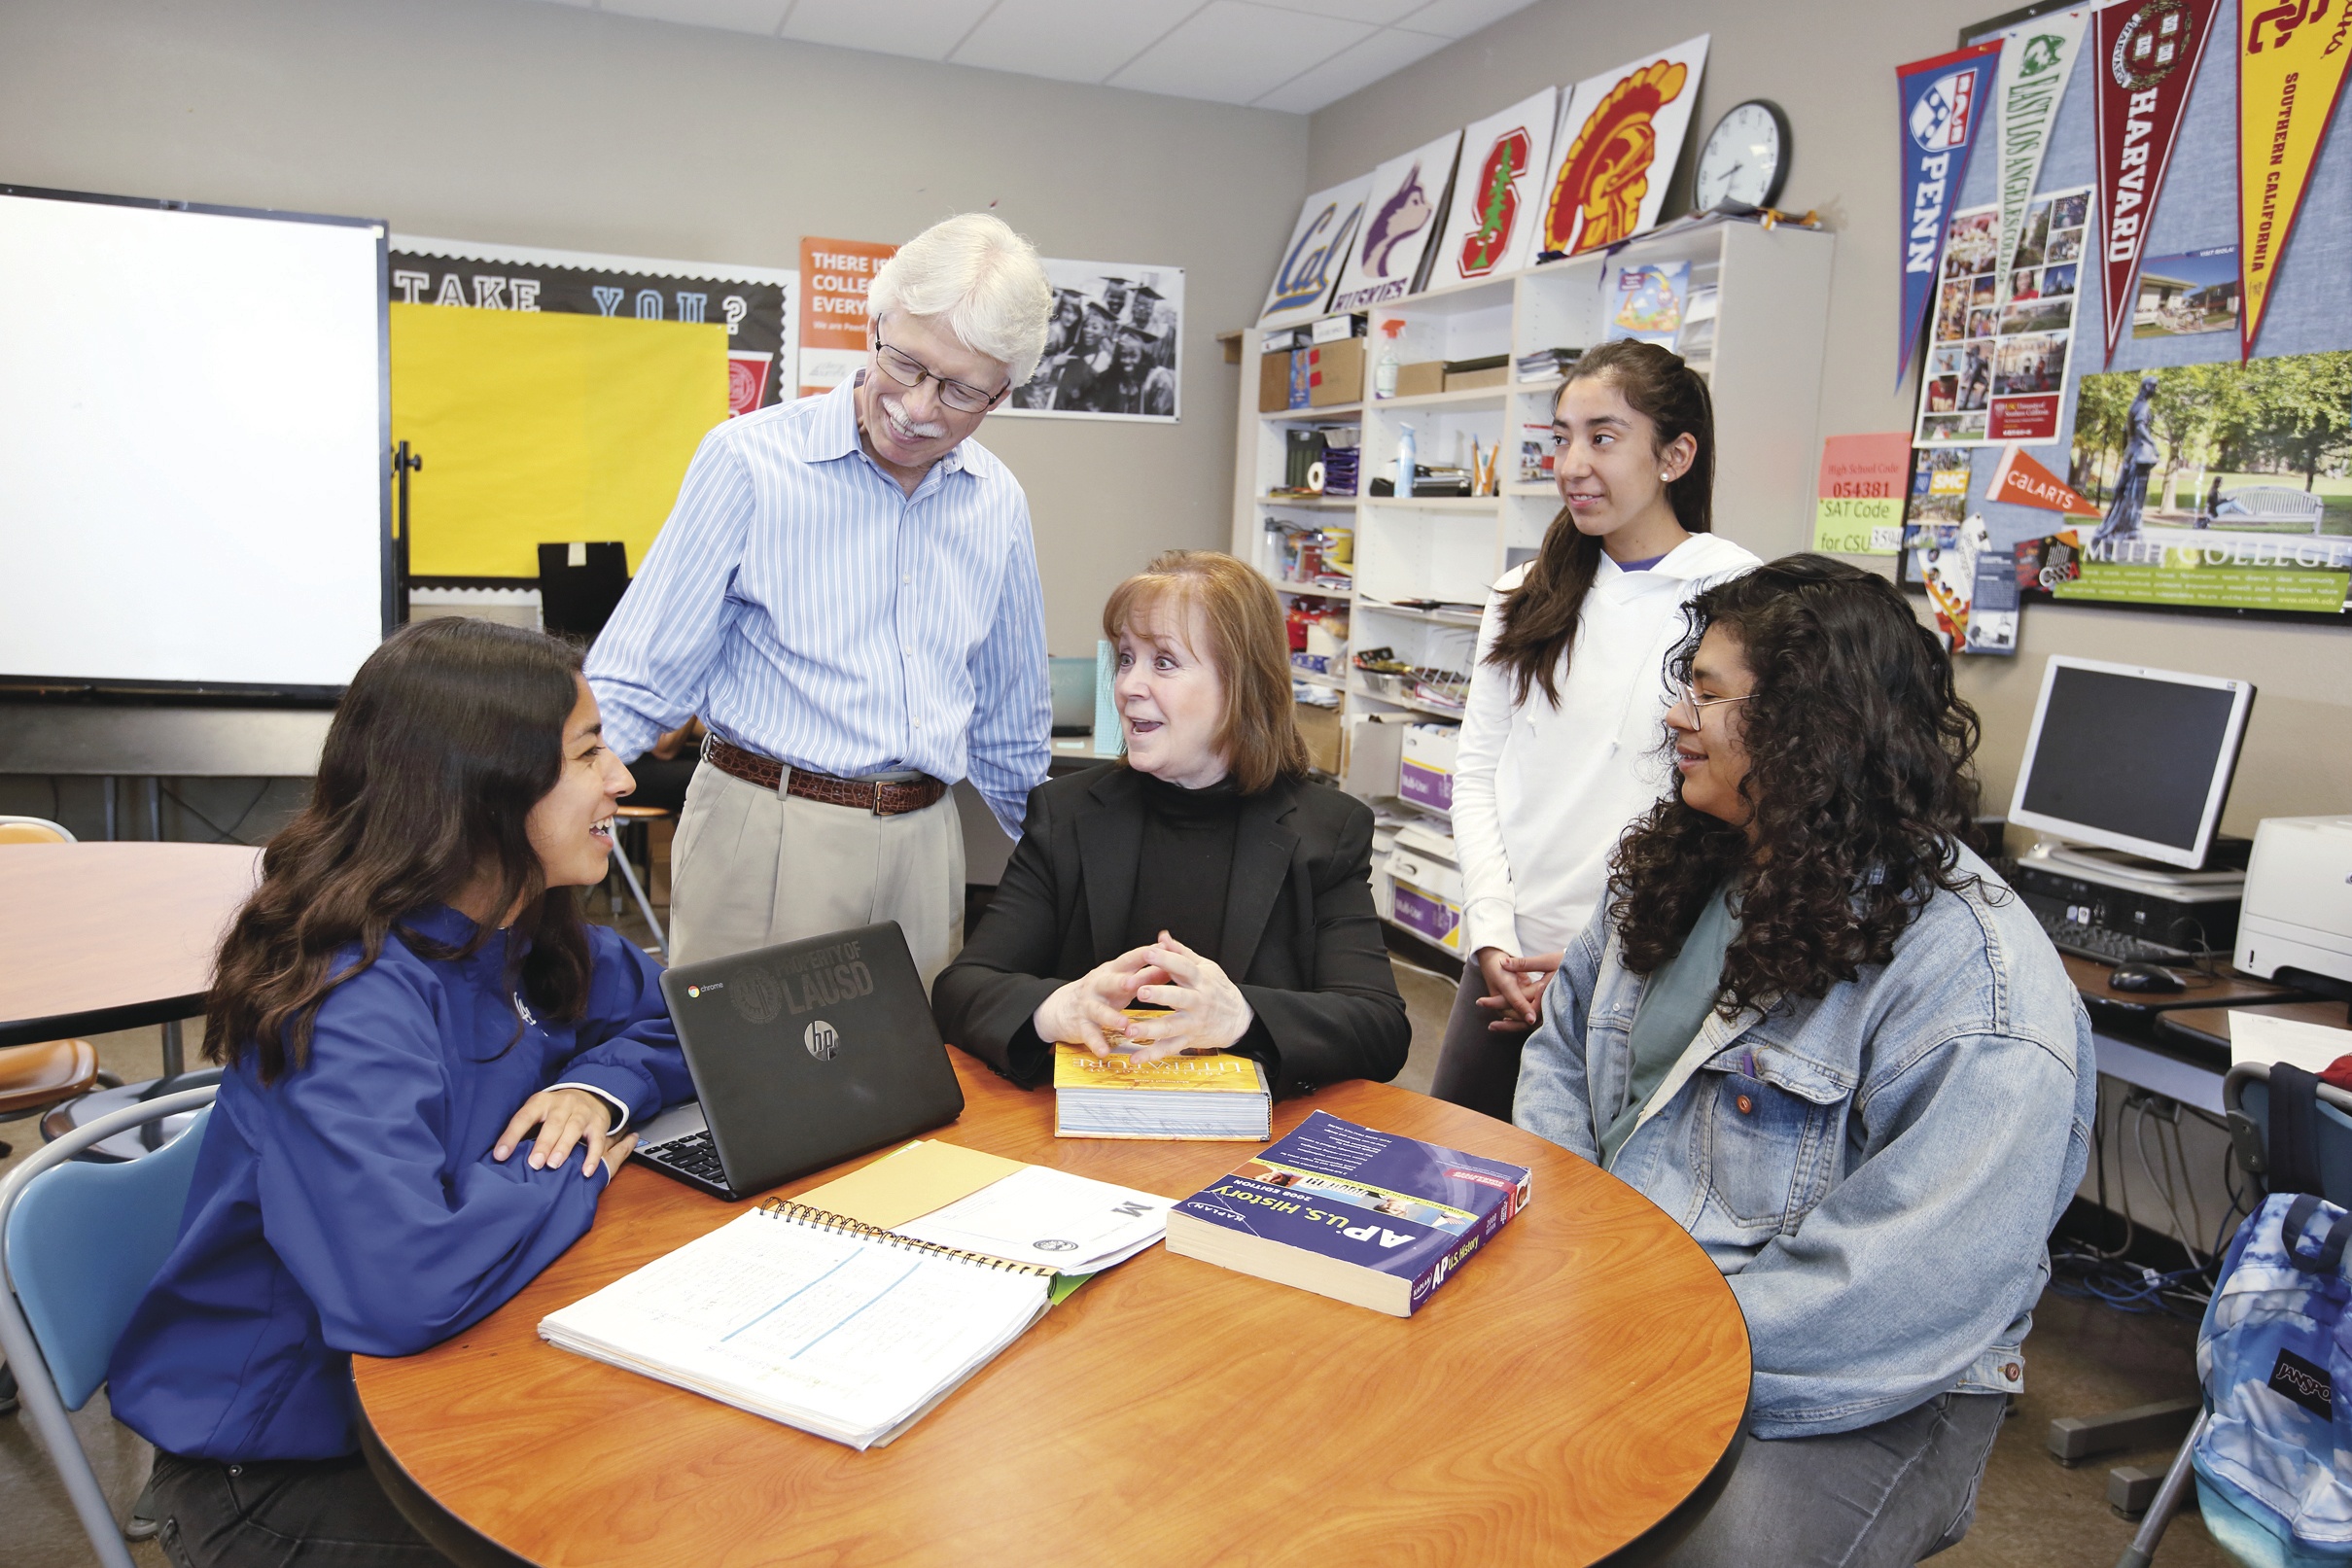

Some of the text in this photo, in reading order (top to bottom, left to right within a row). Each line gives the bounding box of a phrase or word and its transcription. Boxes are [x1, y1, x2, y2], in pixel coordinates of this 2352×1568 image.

[2007, 73, 2060, 121] EAST
[2269, 72, 2299, 165] SOUTHERN
[2006, 118, 2045, 155] LOS
[2004, 157, 2036, 228] ANGELES
[2109, 87, 2159, 263] HARVARD
[1906, 152, 1950, 273] PENN
[2252, 171, 2280, 272] CALIFORNIA
[812, 252, 868, 273] THERE
[1262, 201, 1363, 319] Cal
[394, 270, 541, 313] TAKE
[813, 296, 869, 316] EVERY
[1334, 276, 1408, 311] HUSKIES
[1829, 464, 1899, 475] High School Code
[1933, 472, 1966, 489] SMC
[1833, 481, 1889, 499] 054381
[1824, 501, 1890, 518] SAT Code
[1821, 533, 1871, 552] for CSU
[2082, 538, 2345, 568] MITH COLLEGE
[2277, 596, 2336, 606] www.smith.edu
[844, 941, 861, 959] OF
[700, 982, 723, 993] chrome
[780, 960, 873, 1015] LAUSD
[1233, 1178, 1313, 1202] 2008 EDITION
[1194, 1203, 1246, 1222] KAPLAN
[1210, 1185, 1417, 1248] AP U.S. History
[1431, 1256, 1448, 1290] AP
[1448, 1252, 1459, 1271] U.S.
[1458, 1235, 1479, 1261] History
[2276, 1363, 2332, 1403] JANSPO
